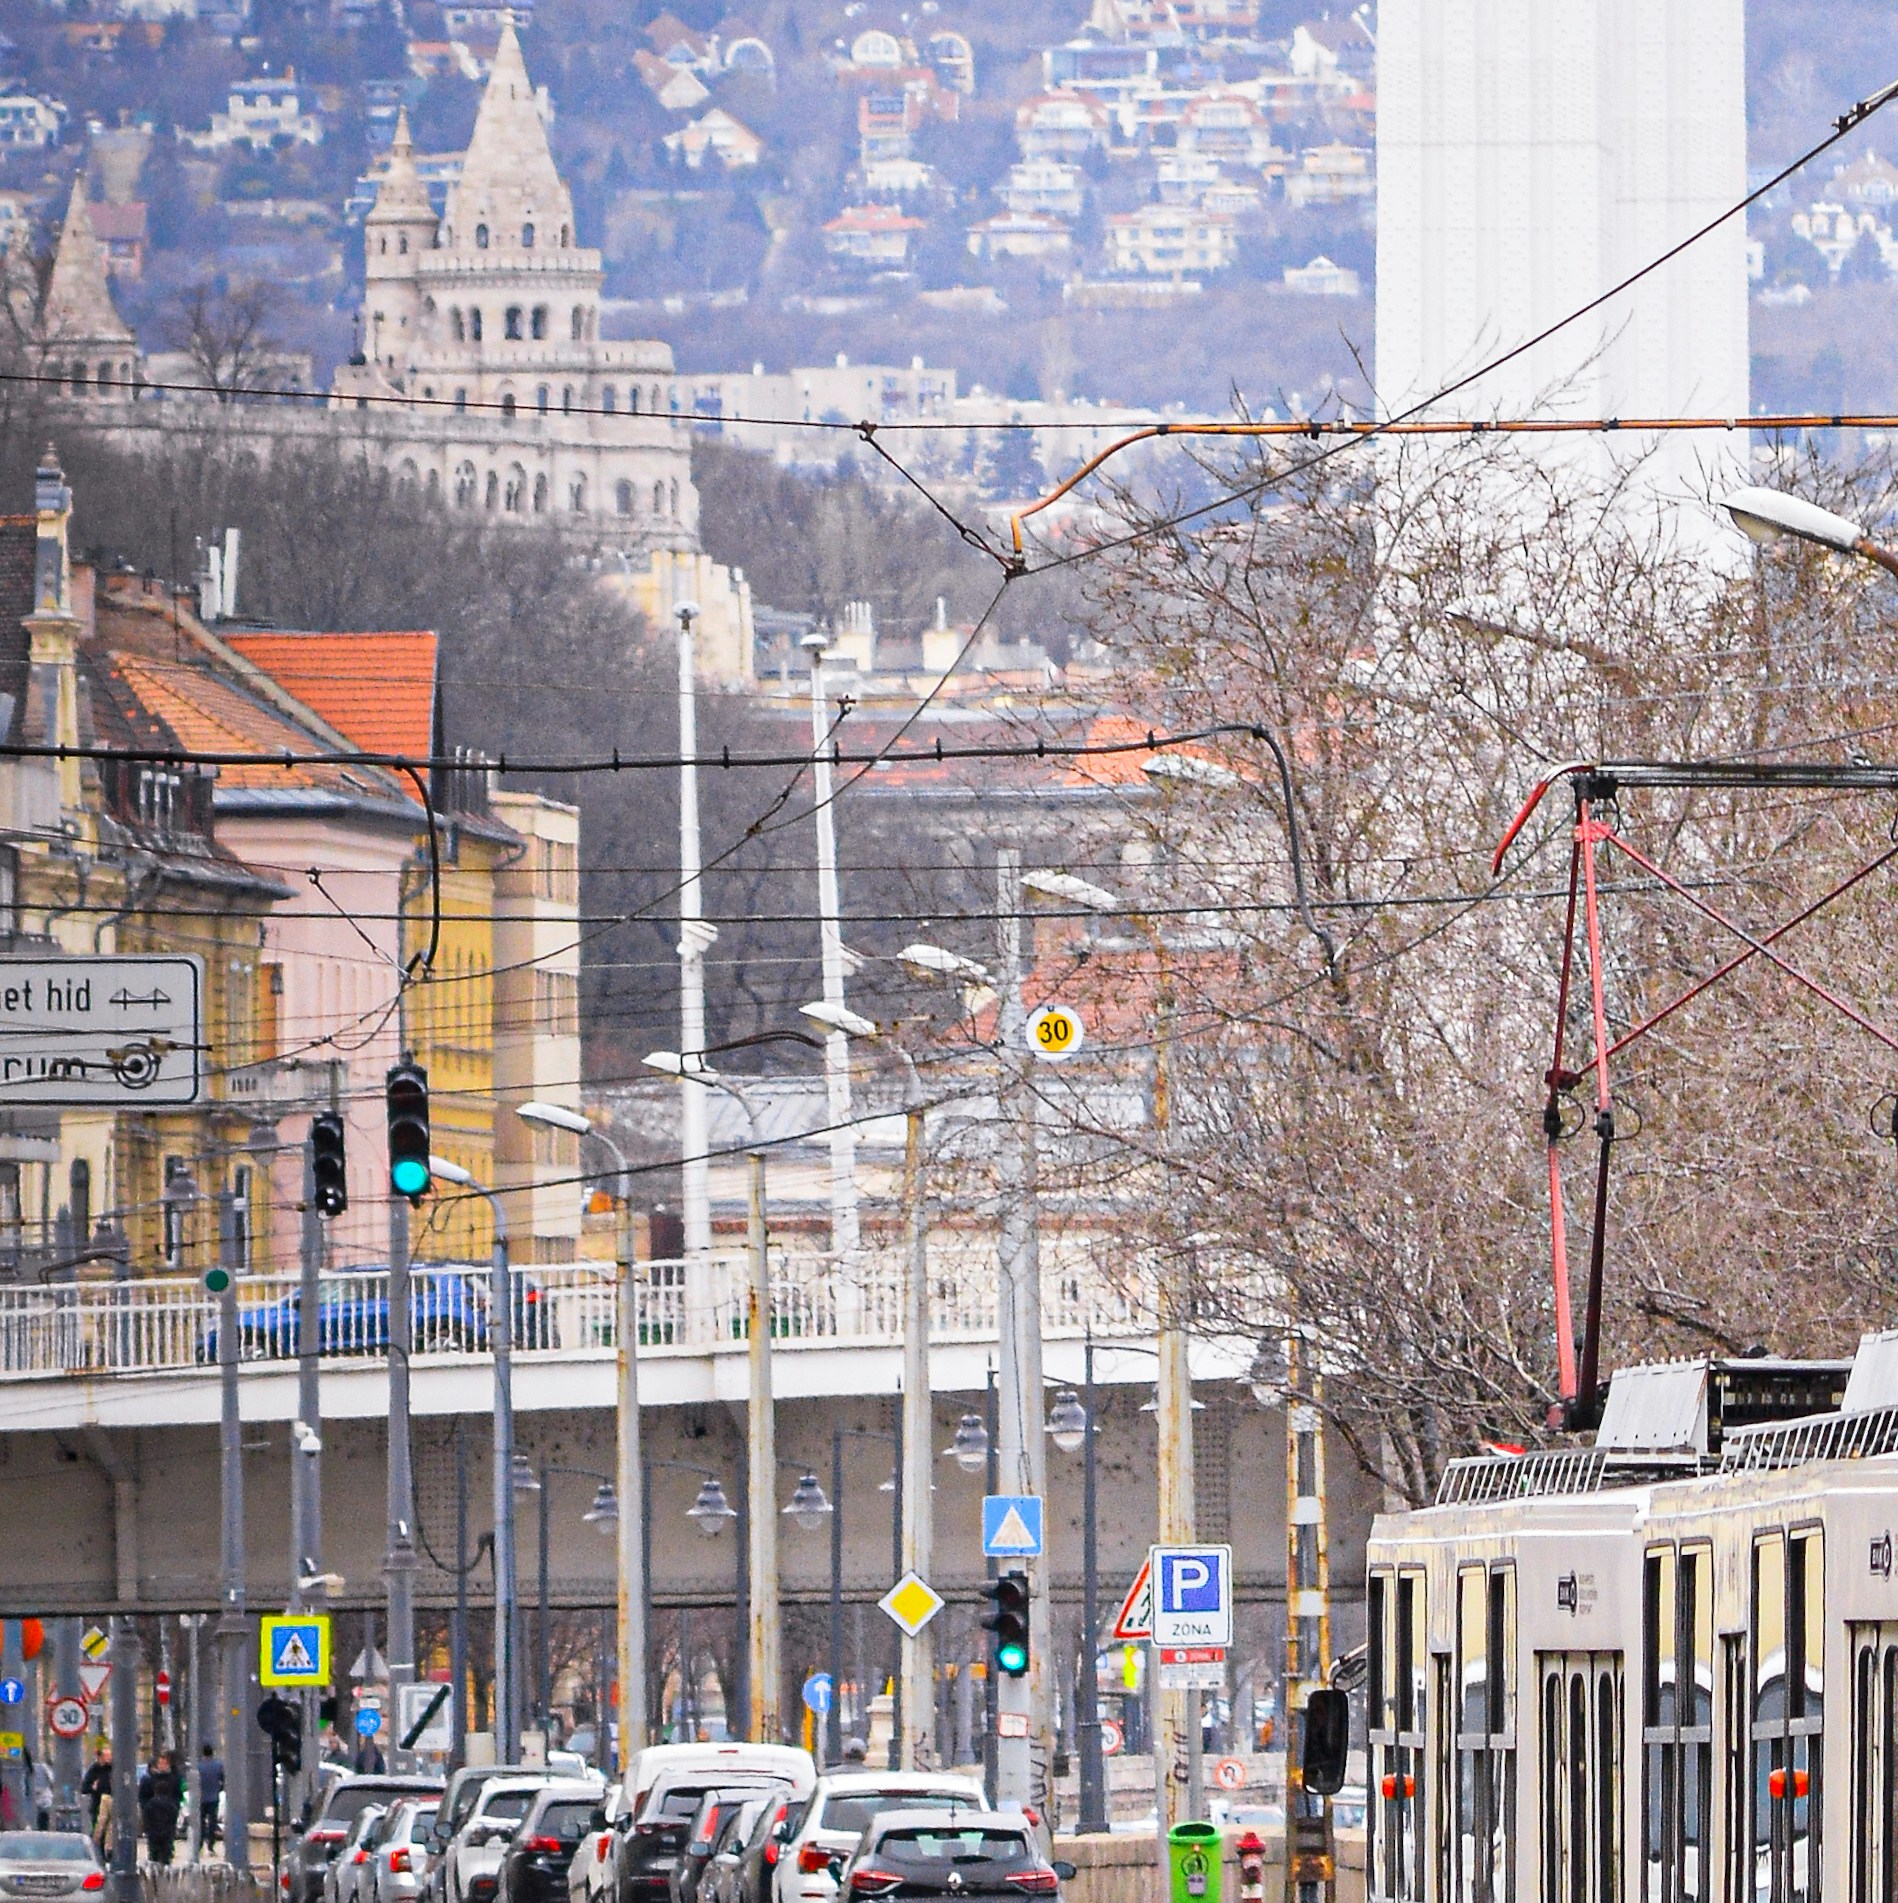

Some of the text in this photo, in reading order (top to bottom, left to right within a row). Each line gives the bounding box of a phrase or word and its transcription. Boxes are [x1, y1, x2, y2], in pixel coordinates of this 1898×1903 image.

[0, 980, 33, 1012] et
[1039, 1019, 1069, 1044] 30
[1172, 1559, 1210, 1610] P
[59, 1708, 80, 1726] 30
